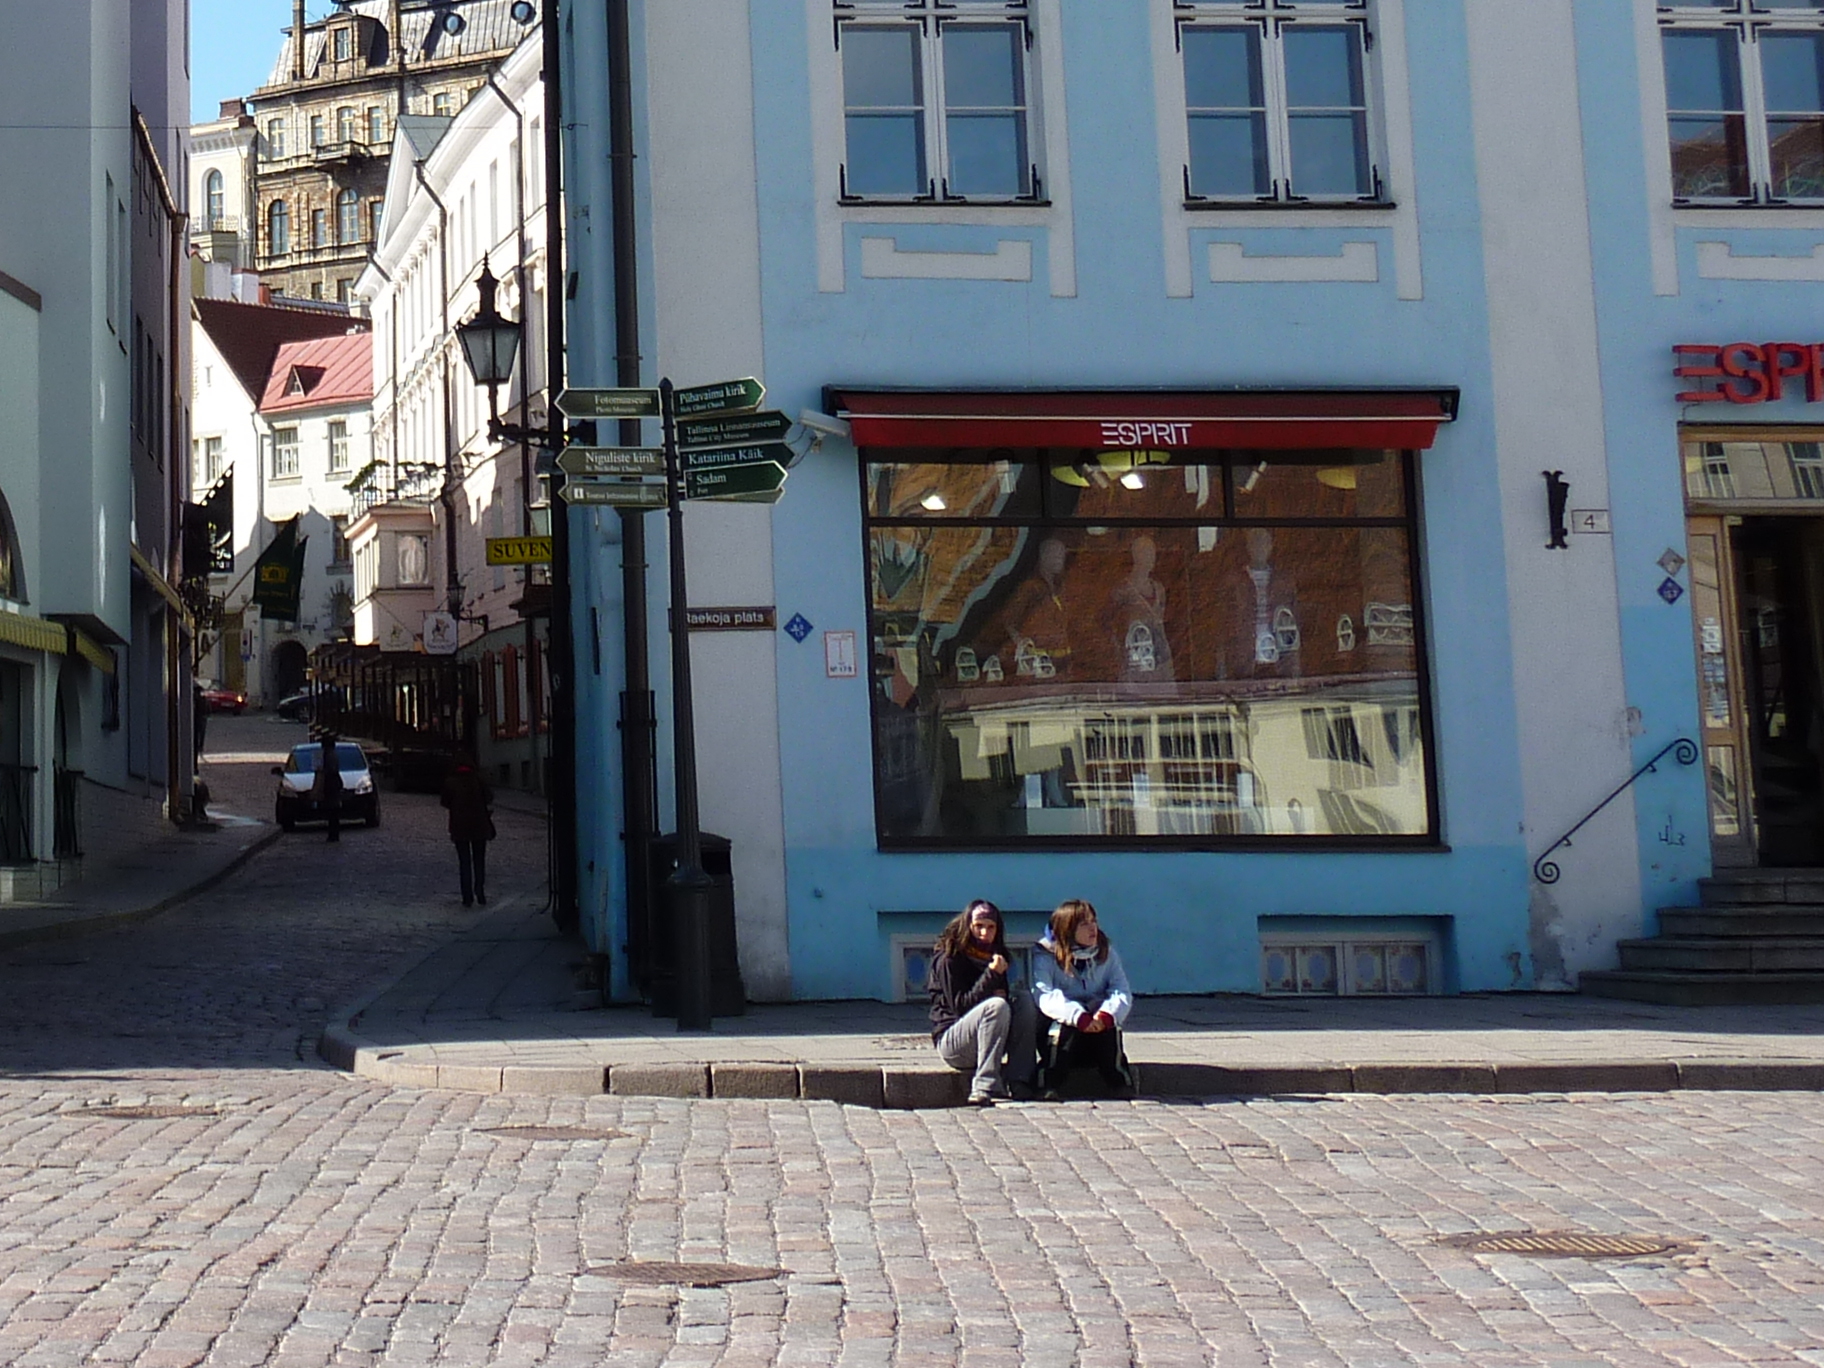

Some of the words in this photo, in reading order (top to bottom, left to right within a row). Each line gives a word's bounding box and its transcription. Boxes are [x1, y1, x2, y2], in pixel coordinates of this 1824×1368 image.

[726, 384, 747, 397] kirik
[1100, 422, 1193, 445] ESPRIT
[585, 452, 631, 464] Niguliste
[633, 452, 656, 463] kirik
[688, 452, 736, 465] Katariina
[738, 448, 764, 460] Käik
[696, 472, 727, 485] Sadam
[1583, 514, 1595, 529] 4
[734, 612, 764, 625] plats
